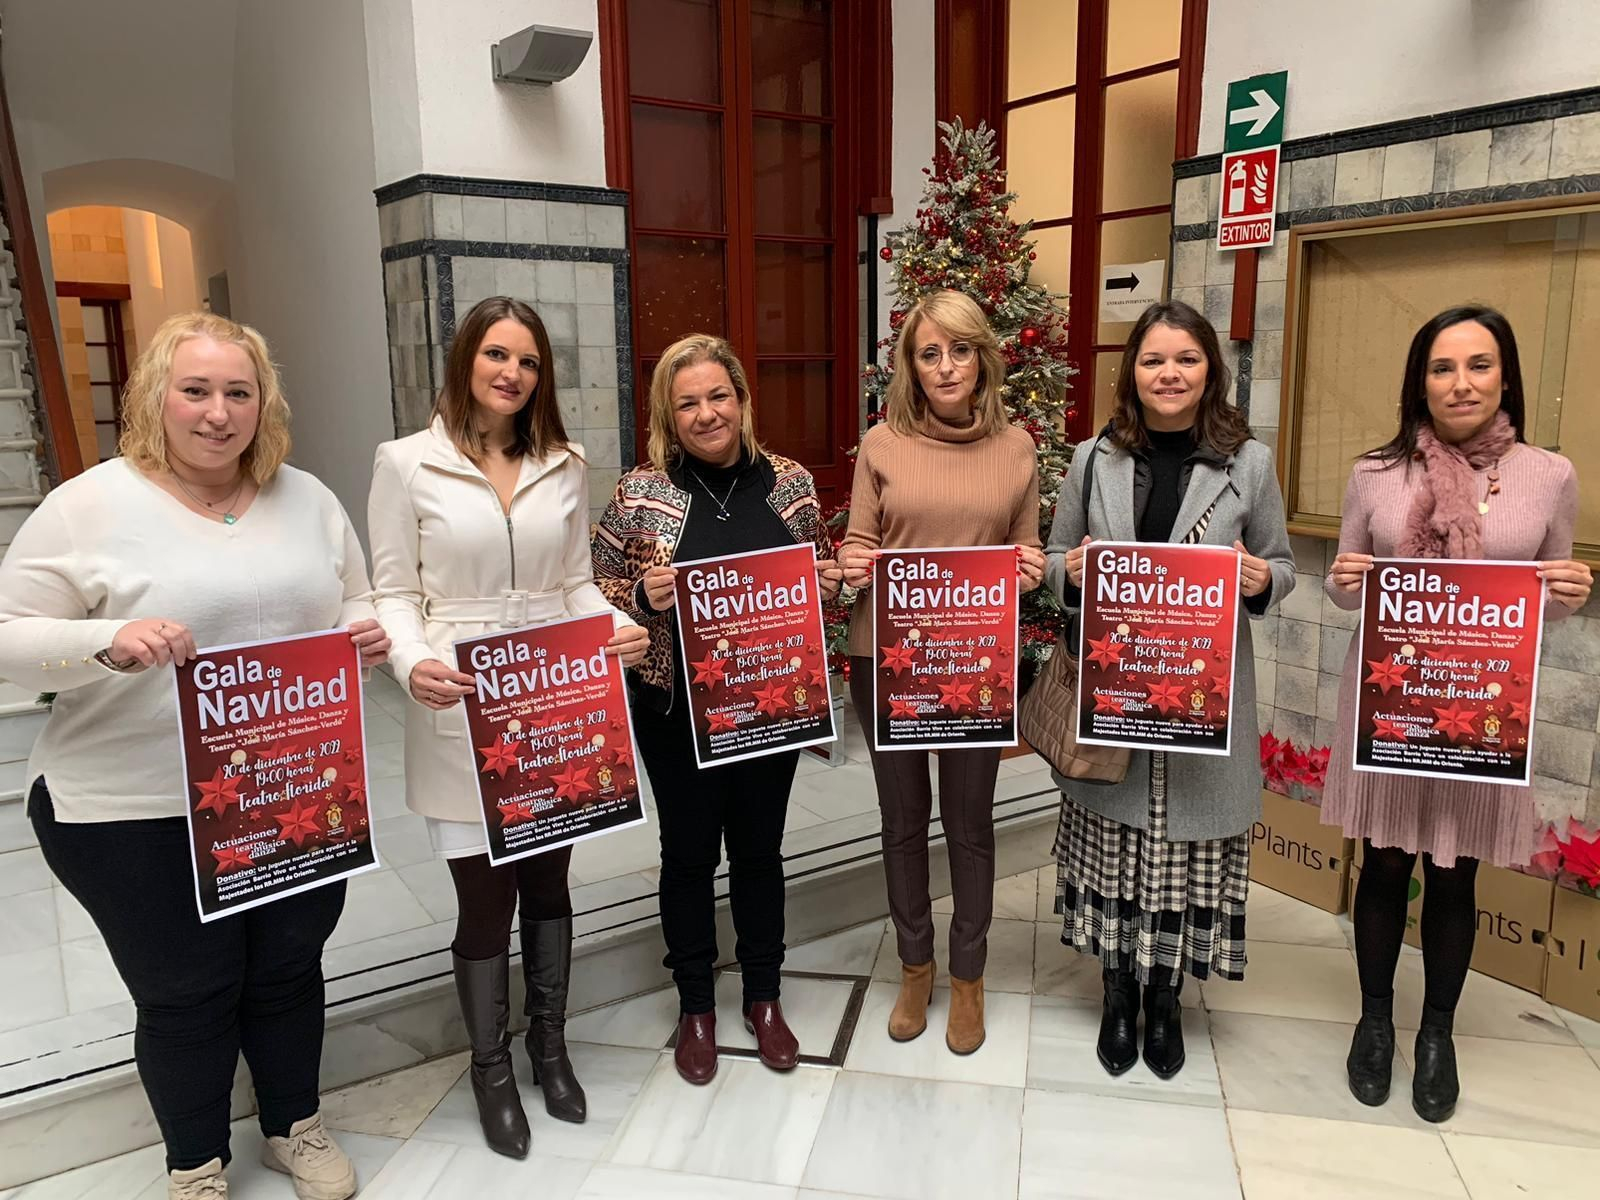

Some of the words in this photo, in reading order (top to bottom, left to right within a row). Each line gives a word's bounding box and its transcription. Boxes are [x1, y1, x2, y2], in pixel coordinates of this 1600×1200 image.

[1221, 222, 1270, 243] EXTINTOR
[887, 557, 938, 580] Gala
[941, 568, 953, 578] de
[1097, 550, 1151, 574] Gala
[1154, 564, 1167, 575] de
[686, 565, 739, 593] Gala
[741, 574, 754, 584] de
[1097, 571, 1224, 607] Navidad
[1379, 567, 1441, 592] Gala
[1444, 582, 1460, 593] de
[690, 575, 807, 622] Navidad
[888, 577, 1005, 609] Navidad
[1378, 589, 1526, 628] Navidad
[711, 647, 722, 661] 20
[722, 648, 732, 657] de
[734, 642, 772, 655] diciembre
[774, 639, 783, 648] de
[786, 634, 803, 647] 2022
[901, 636, 913, 649] 20
[912, 638, 922, 647] de
[925, 637, 963, 647] diciembre
[965, 636, 974, 645] de
[977, 635, 996, 646] 2022
[1109, 631, 1122, 643] 20
[1121, 633, 1131, 643] de
[1134, 634, 1175, 645] diciembre
[1178, 637, 1188, 646] de
[1191, 636, 1212, 649] 2022
[470, 639, 530, 670] Gala
[533, 647, 546, 658] de
[760, 653, 782, 663] horas
[949, 649, 972, 658] horas
[1117, 657, 1153, 672] Teatro
[1160, 648, 1184, 659] horas
[1392, 652, 1406, 665] 20
[1405, 654, 1417, 665] de
[1420, 656, 1467, 668] diciembre
[1471, 659, 1482, 669] de
[1486, 658, 1510, 672] 2022
[193, 655, 263, 690] Gala
[266, 666, 281, 678] de
[475, 647, 608, 703] Navidad
[722, 671, 757, 687] Teatro
[910, 661, 944, 676] Teatro
[1450, 670, 1478, 682] horas
[197, 667, 346, 729] Navidad
[888, 691, 939, 701] Actuaciones
[1093, 686, 1146, 698] Actuaciones
[1401, 680, 1441, 696] Teatro
[705, 701, 755, 716] Actuaciones
[1372, 710, 1433, 723] Actuaciones
[201, 731, 233, 743] Escuela
[235, 721, 275, 737] Municipal
[276, 720, 286, 728] de
[318, 710, 342, 719] Danza
[342, 708, 348, 716] y
[501, 729, 514, 745] 20
[513, 729, 526, 740] de
[528, 721, 571, 737] diciembre
[573, 716, 583, 726] de
[586, 709, 606, 725] 2022
[208, 742, 236, 752] Teatro
[557, 731, 582, 743] horas
[222, 761, 237, 779] 20
[237, 761, 250, 773] de
[253, 752, 301, 770] diciembre
[304, 747, 315, 757] de
[319, 739, 340, 756] 2022
[515, 753, 554, 773] Teatro
[255, 767, 283, 787] 19:00
[286, 764, 313, 778] horas
[236, 789, 280, 811] Teatro
[497, 787, 554, 807] Actuaciones
[211, 828, 277, 852] Actuaciones
[1251, 821, 1322, 870] Plants
[1476, 908, 1522, 944] nts
